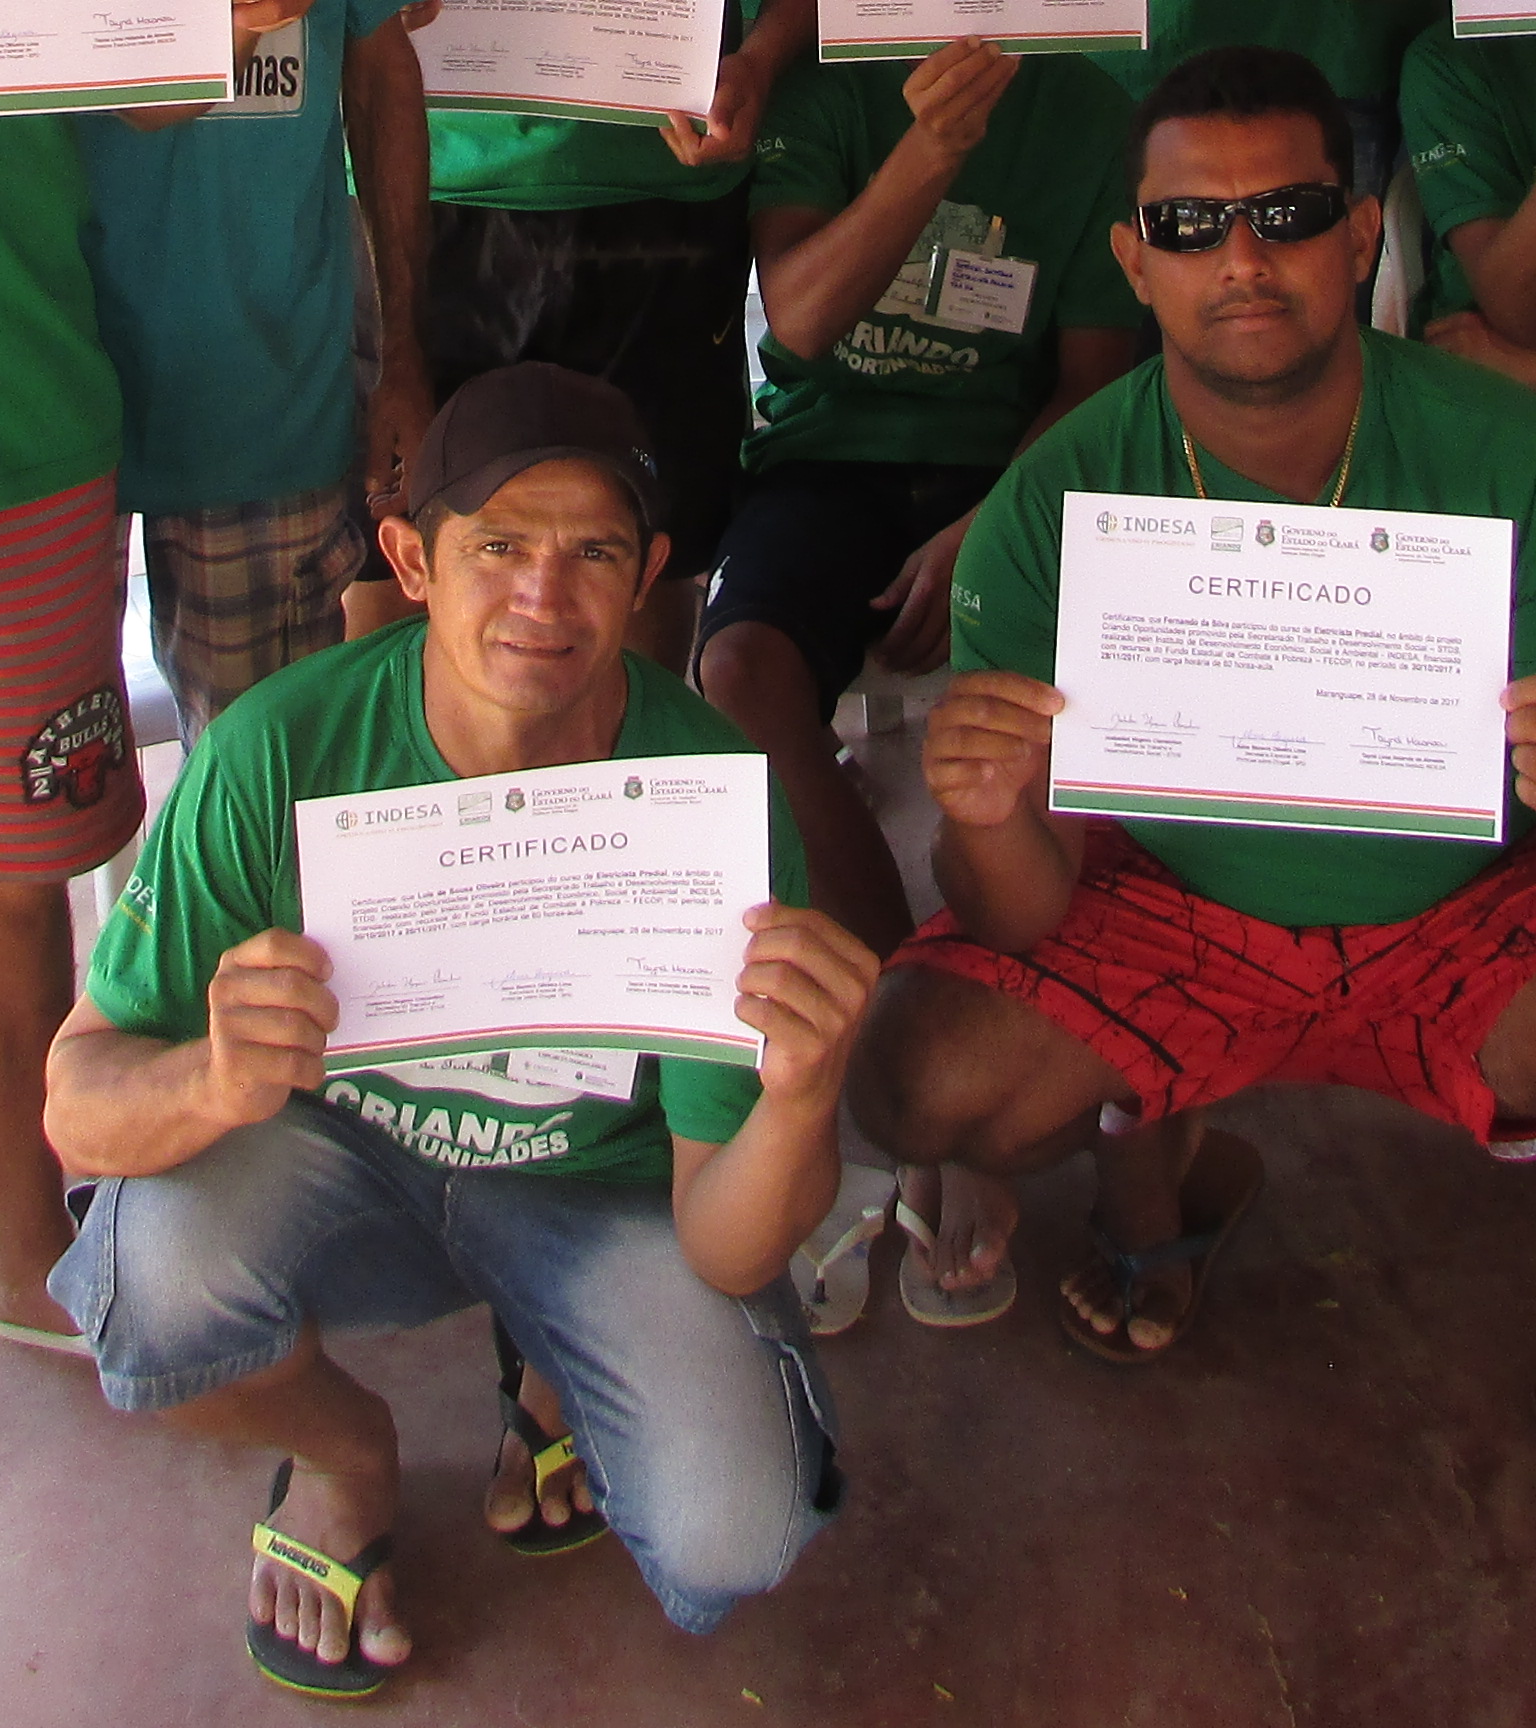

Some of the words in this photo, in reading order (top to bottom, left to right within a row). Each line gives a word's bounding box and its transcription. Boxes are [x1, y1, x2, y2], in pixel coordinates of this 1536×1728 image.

[1122, 516, 1197, 535] INDESA
[1188, 575, 1372, 606] CERTIFICADO
[364, 803, 443, 825] INDESA
[439, 832, 628, 867] CERTIFICADO
